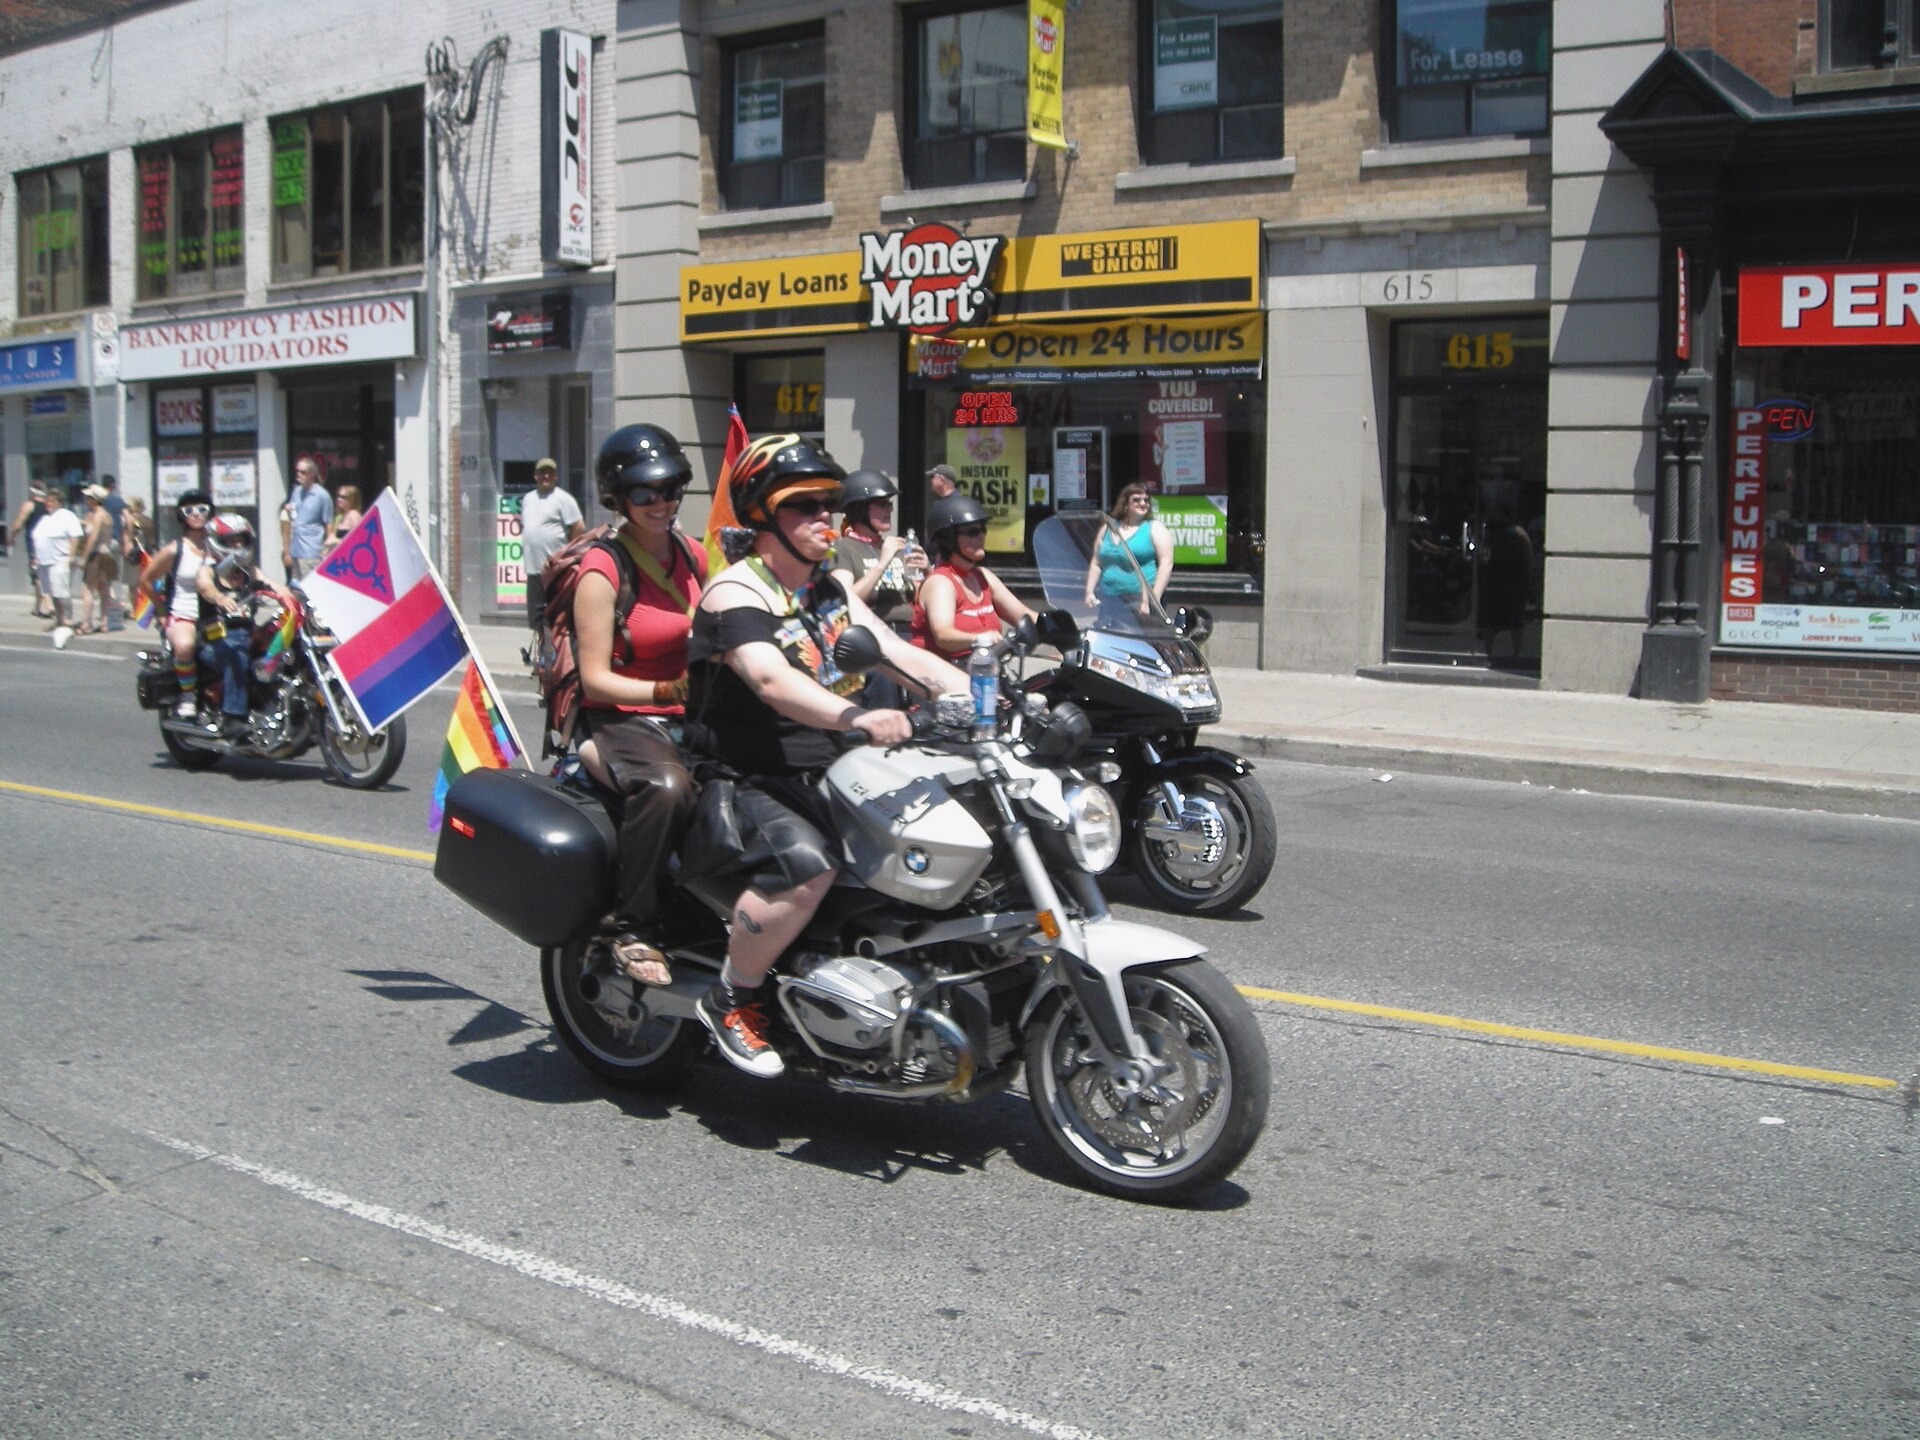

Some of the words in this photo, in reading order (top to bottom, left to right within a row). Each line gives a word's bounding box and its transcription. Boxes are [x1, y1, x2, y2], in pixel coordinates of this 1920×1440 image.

[1410, 49, 1441, 70] For
[1450, 47, 1524, 70] Lease
[861, 231, 999, 288] Money
[1063, 239, 1159, 260] WESTERN
[1092, 255, 1159, 273] UNION
[688, 275, 771, 306] Payday
[779, 271, 849, 296] Loans
[1383, 273, 1433, 301] 615
[1781, 271, 1920, 328] PER
[870, 279, 976, 327] Mart
[128, 313, 282, 350] BANKRUPTCY
[288, 301, 408, 332] FASHION
[181, 334, 350, 371] LIQUIDATORS
[989, 329, 1079, 363] Open
[1091, 327, 1132, 356] 24
[1144, 324, 1246, 354] Hours
[1447, 332, 1515, 369] 615
[775, 383, 823, 415] 617
[960, 391, 1013, 408] OPEN
[1148, 398, 1214, 414] COVERED!
[159, 401, 203, 425] BOOKS
[955, 408, 978, 425] 24
[980, 407, 1019, 424] HRS
[1767, 408, 1815, 430] PEN
[960, 465, 1010, 478] INSTANT
[956, 479, 1018, 505] CASH
[1728, 411, 1763, 598] PERFUMES
[1184, 513, 1217, 527] NEED
[1728, 630, 1780, 640] GUCCI
[1802, 634, 1836, 642] LOWEST
[1839, 635, 1864, 643] PRICE
